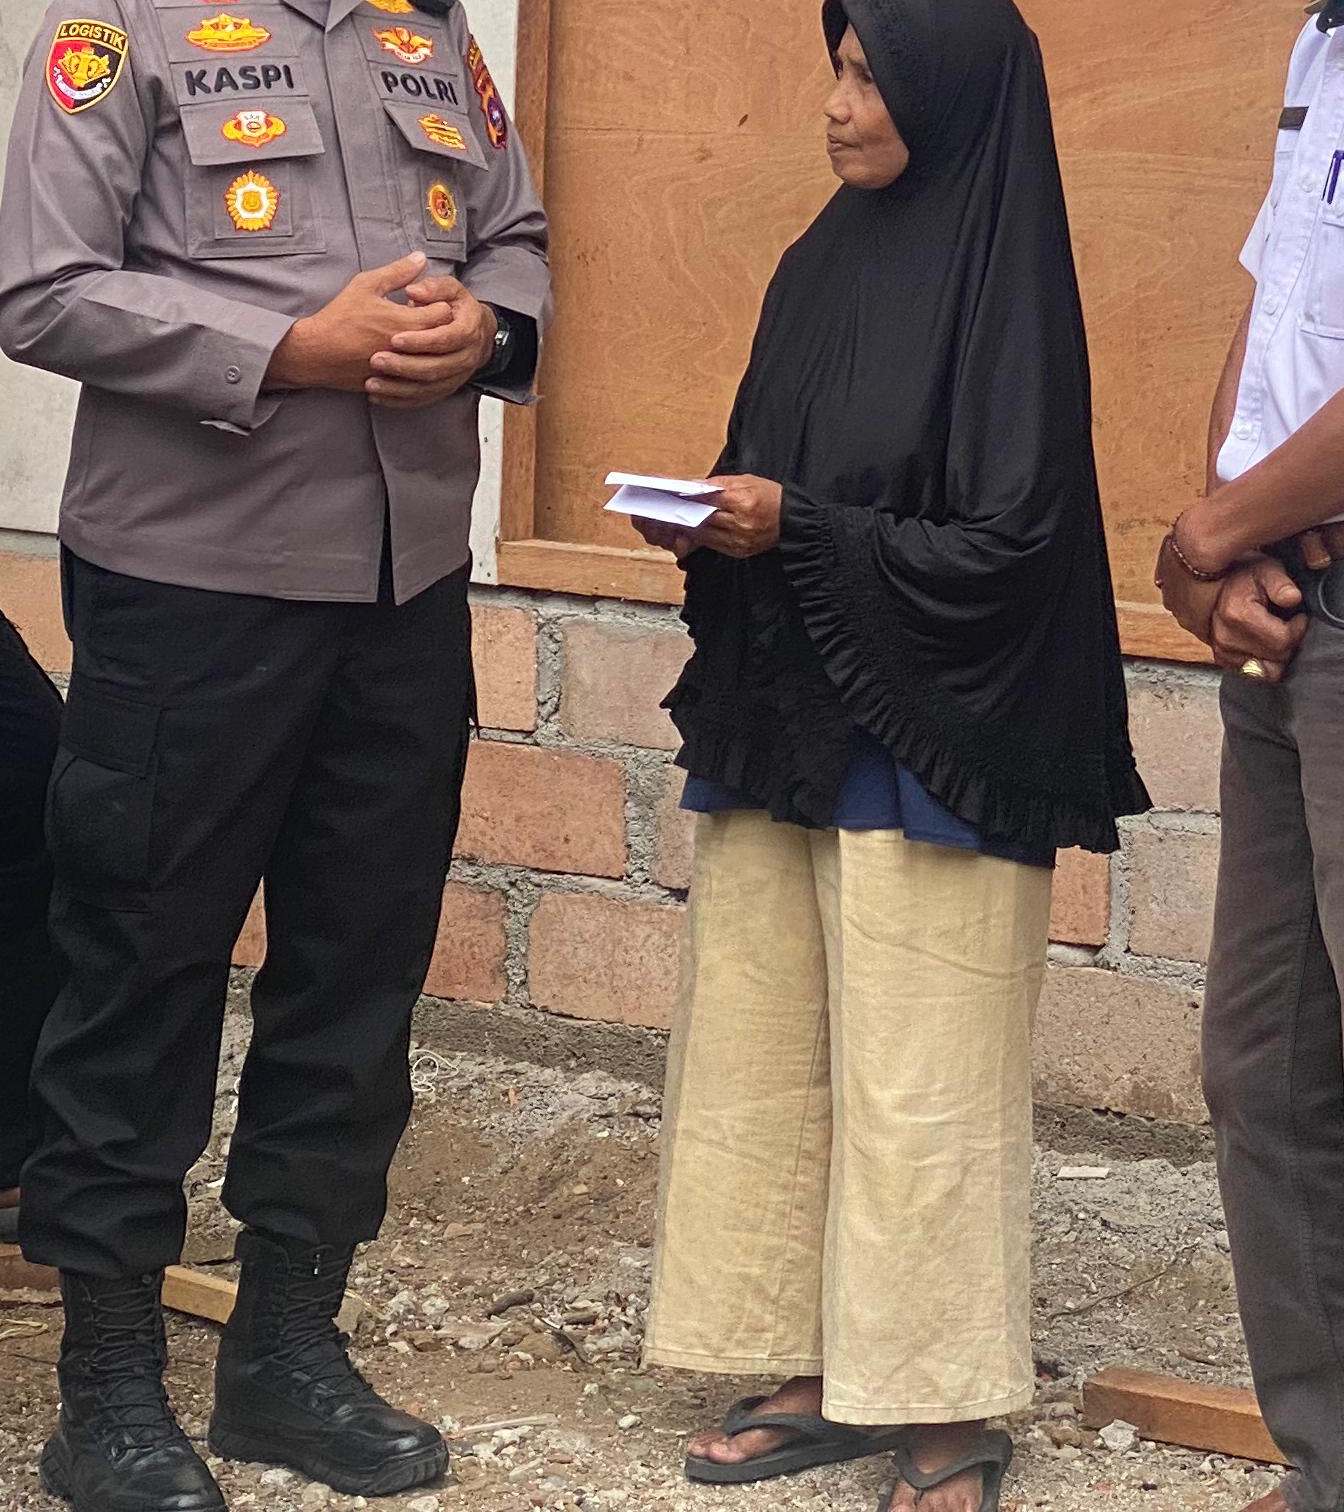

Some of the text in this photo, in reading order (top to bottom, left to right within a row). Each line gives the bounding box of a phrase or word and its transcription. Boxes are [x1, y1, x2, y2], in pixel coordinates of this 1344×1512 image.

[60, 23, 125, 49] LOGISTIK
[184, 64, 294, 96] KASPI
[380, 71, 459, 106] POLRI
